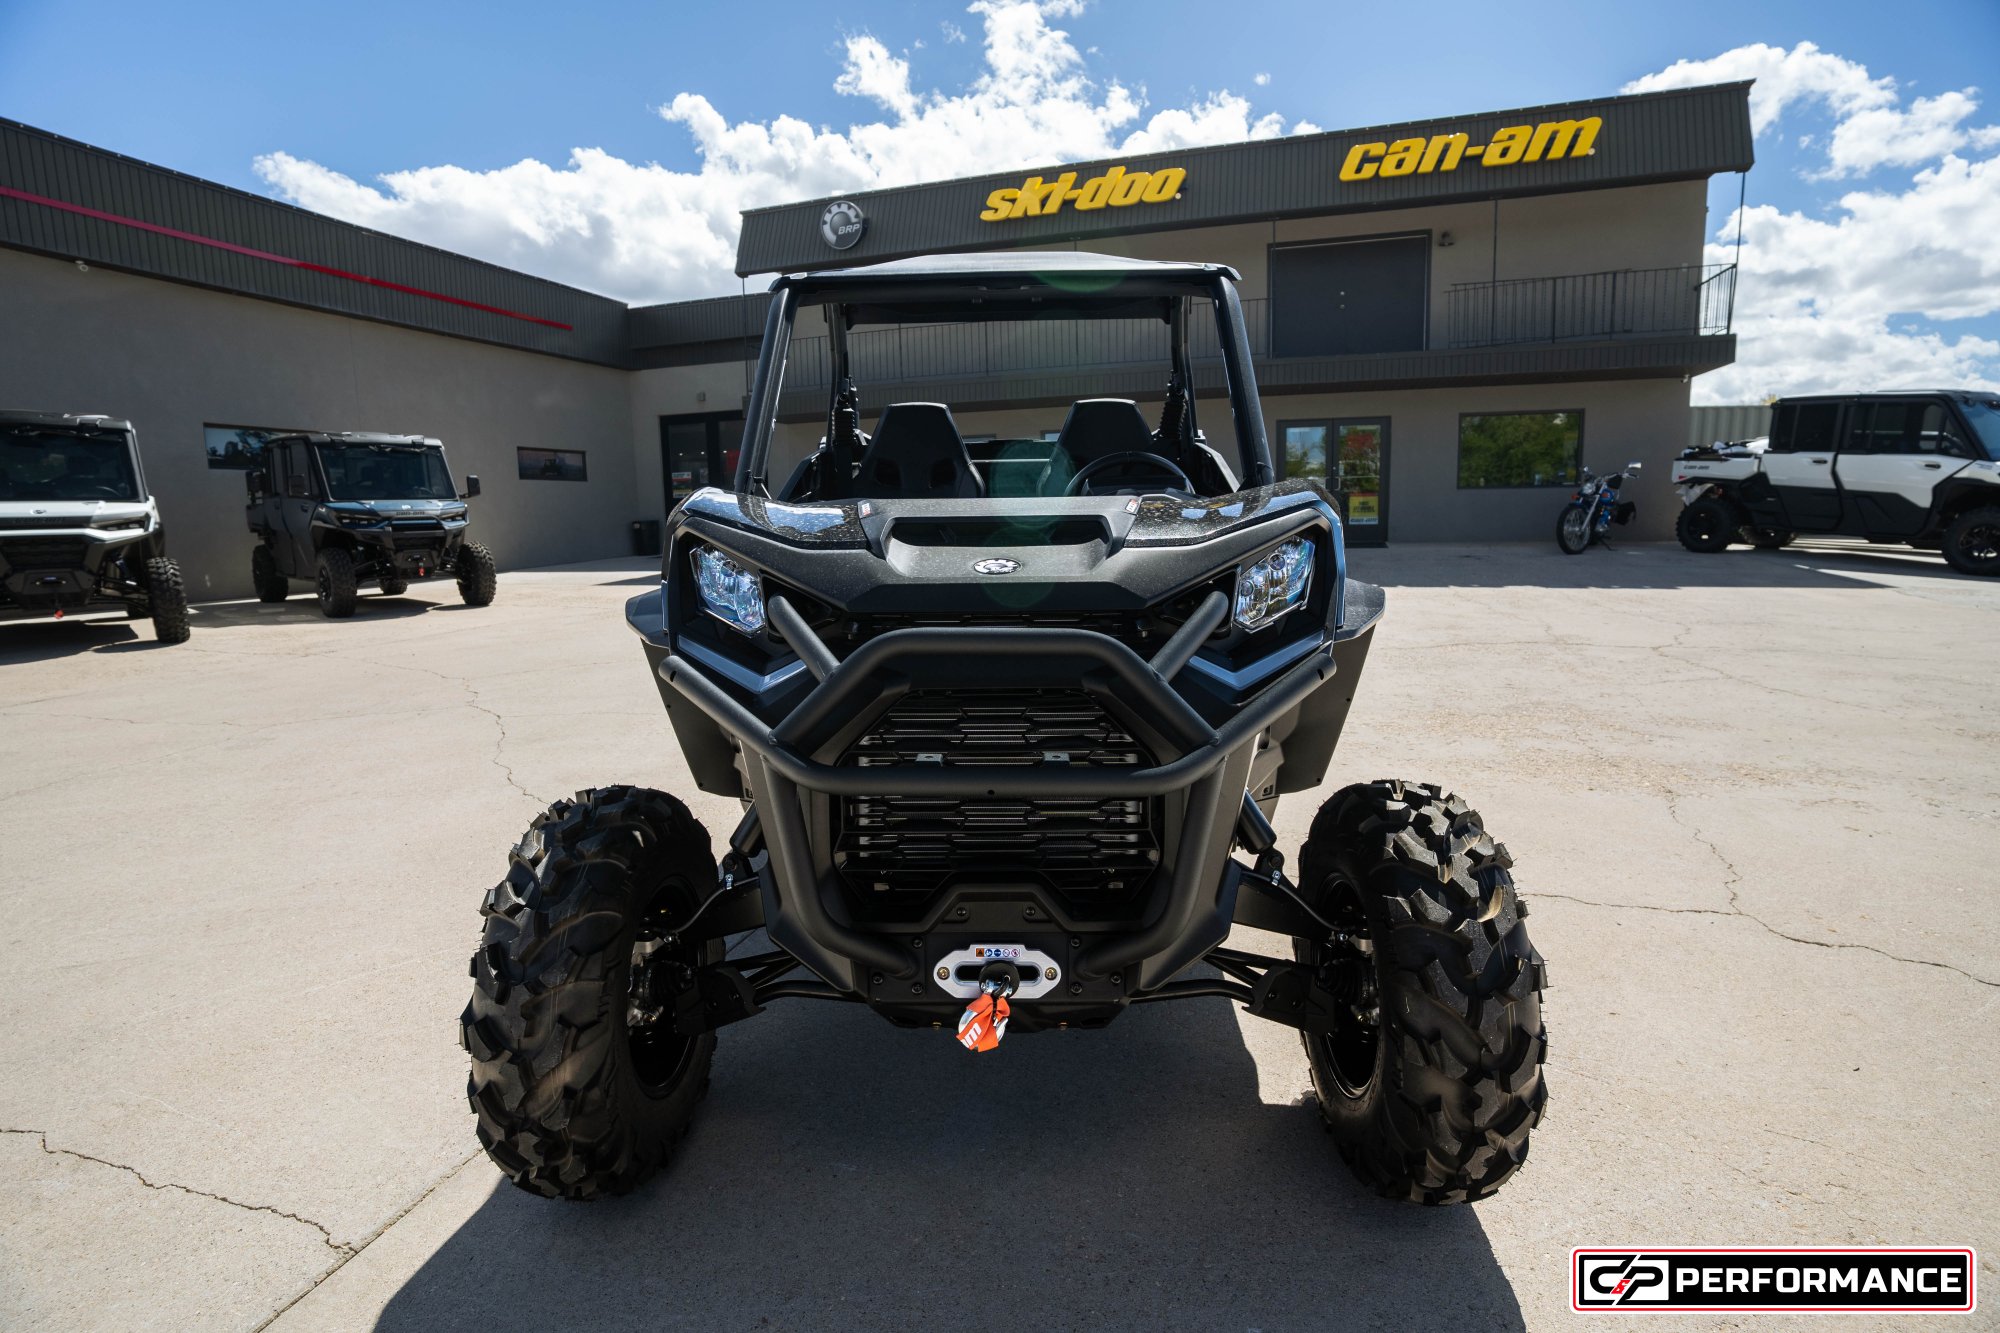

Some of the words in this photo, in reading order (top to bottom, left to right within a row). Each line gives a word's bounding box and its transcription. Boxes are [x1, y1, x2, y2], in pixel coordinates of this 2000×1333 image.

[1339, 116, 1603, 182] can-am
[980, 165, 1187, 222] ski-doo
[838, 223, 860, 235] BRP
